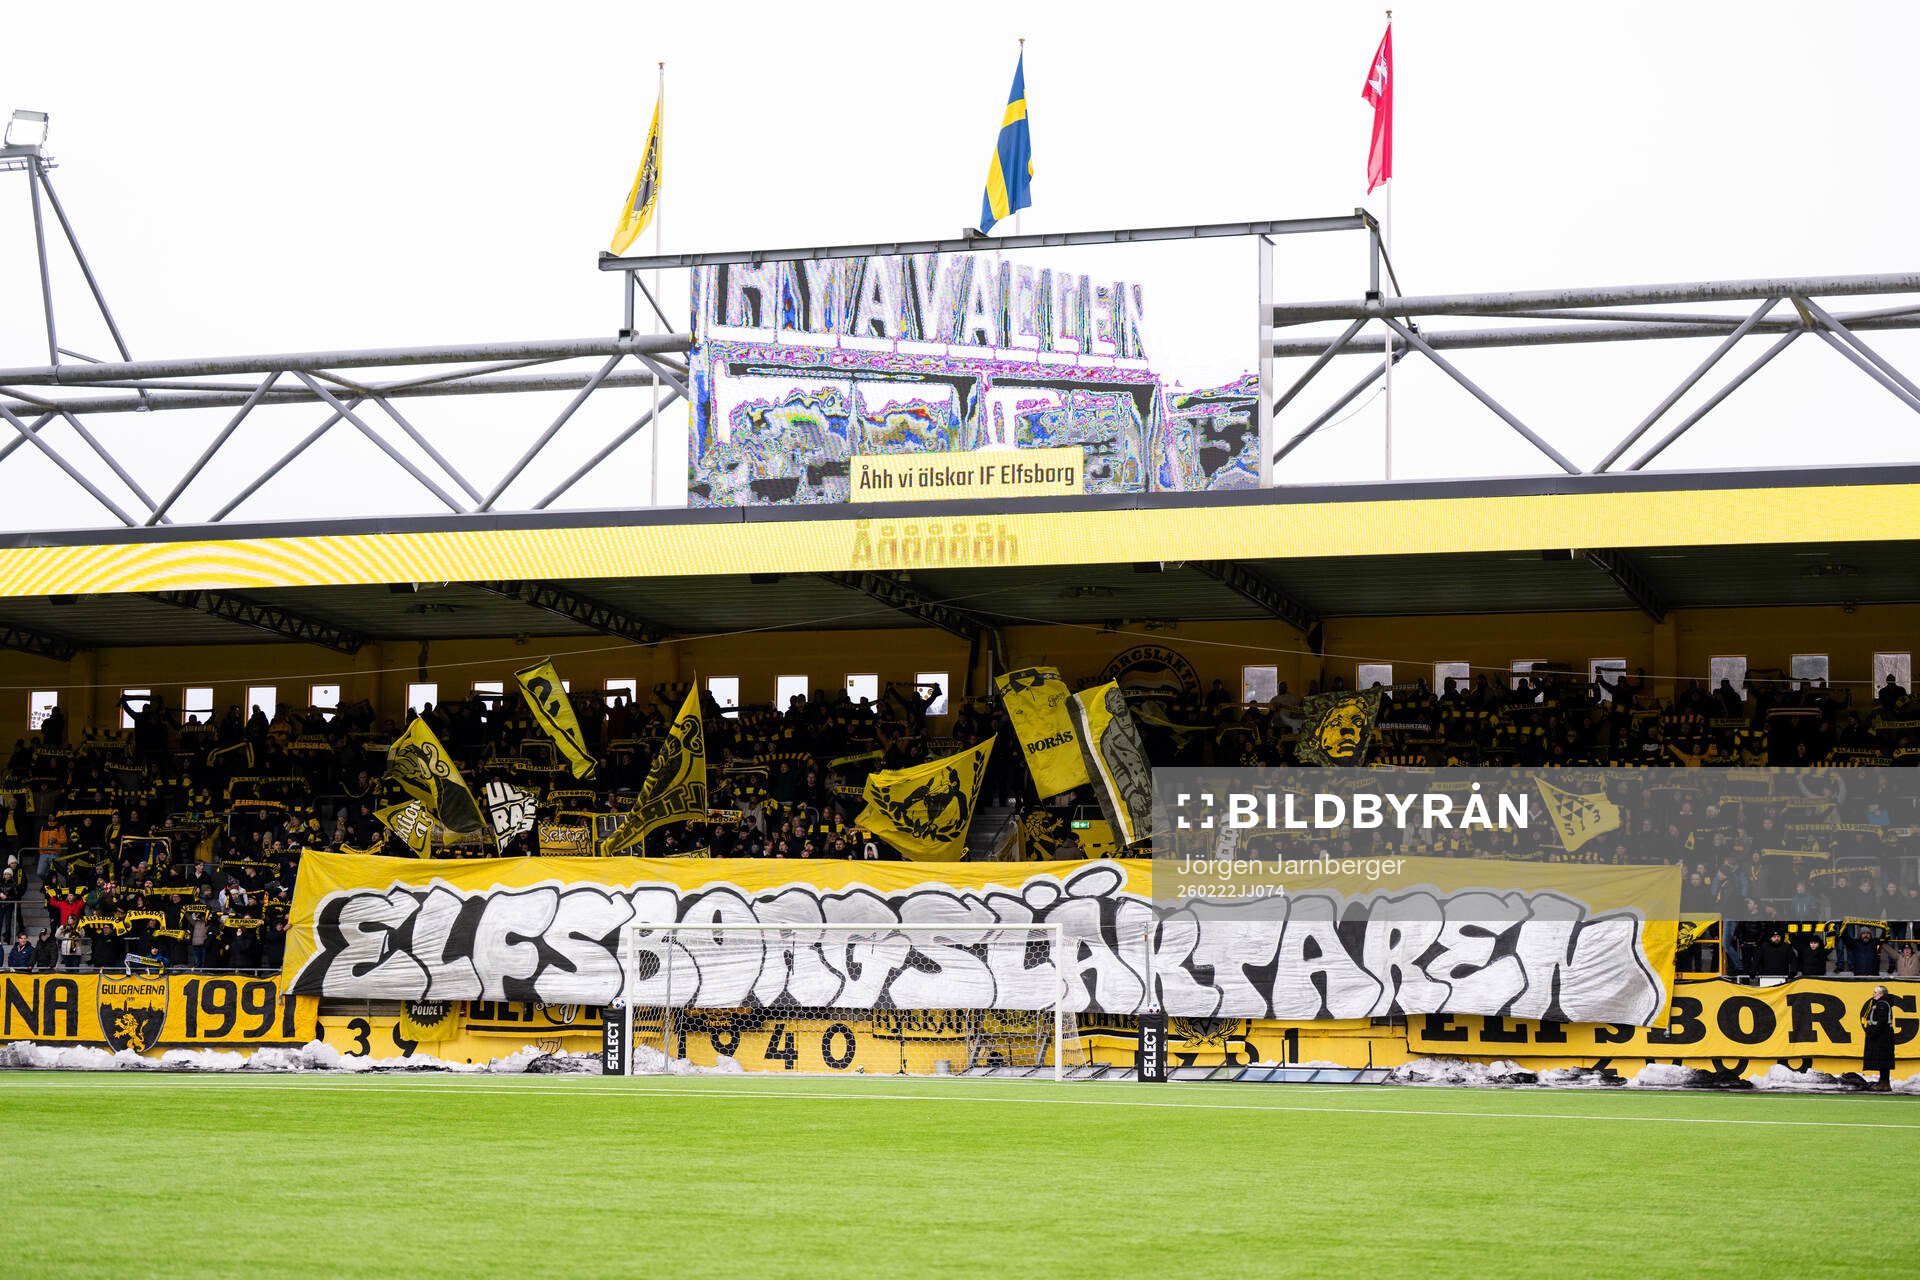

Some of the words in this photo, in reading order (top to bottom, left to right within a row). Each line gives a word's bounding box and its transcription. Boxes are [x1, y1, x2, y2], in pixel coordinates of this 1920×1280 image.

[860, 464, 893, 489] Åhh
[899, 467, 913, 487] vi
[918, 466, 975, 487] älskar
[980, 465, 996, 485] IF
[1001, 463, 1075, 486] Elfsborg
[305, 862, 1660, 1024] ELFSBORGSLÄKTAREN
[0, 978, 79, 1037] NA
[183, 978, 297, 1039] 1991
[101, 984, 166, 995] GULIGANERNA
[411, 1004, 438, 1016] POLICE
[607, 1021, 619, 1070] SELECT
[1143, 1026, 1157, 1077] SELECT
